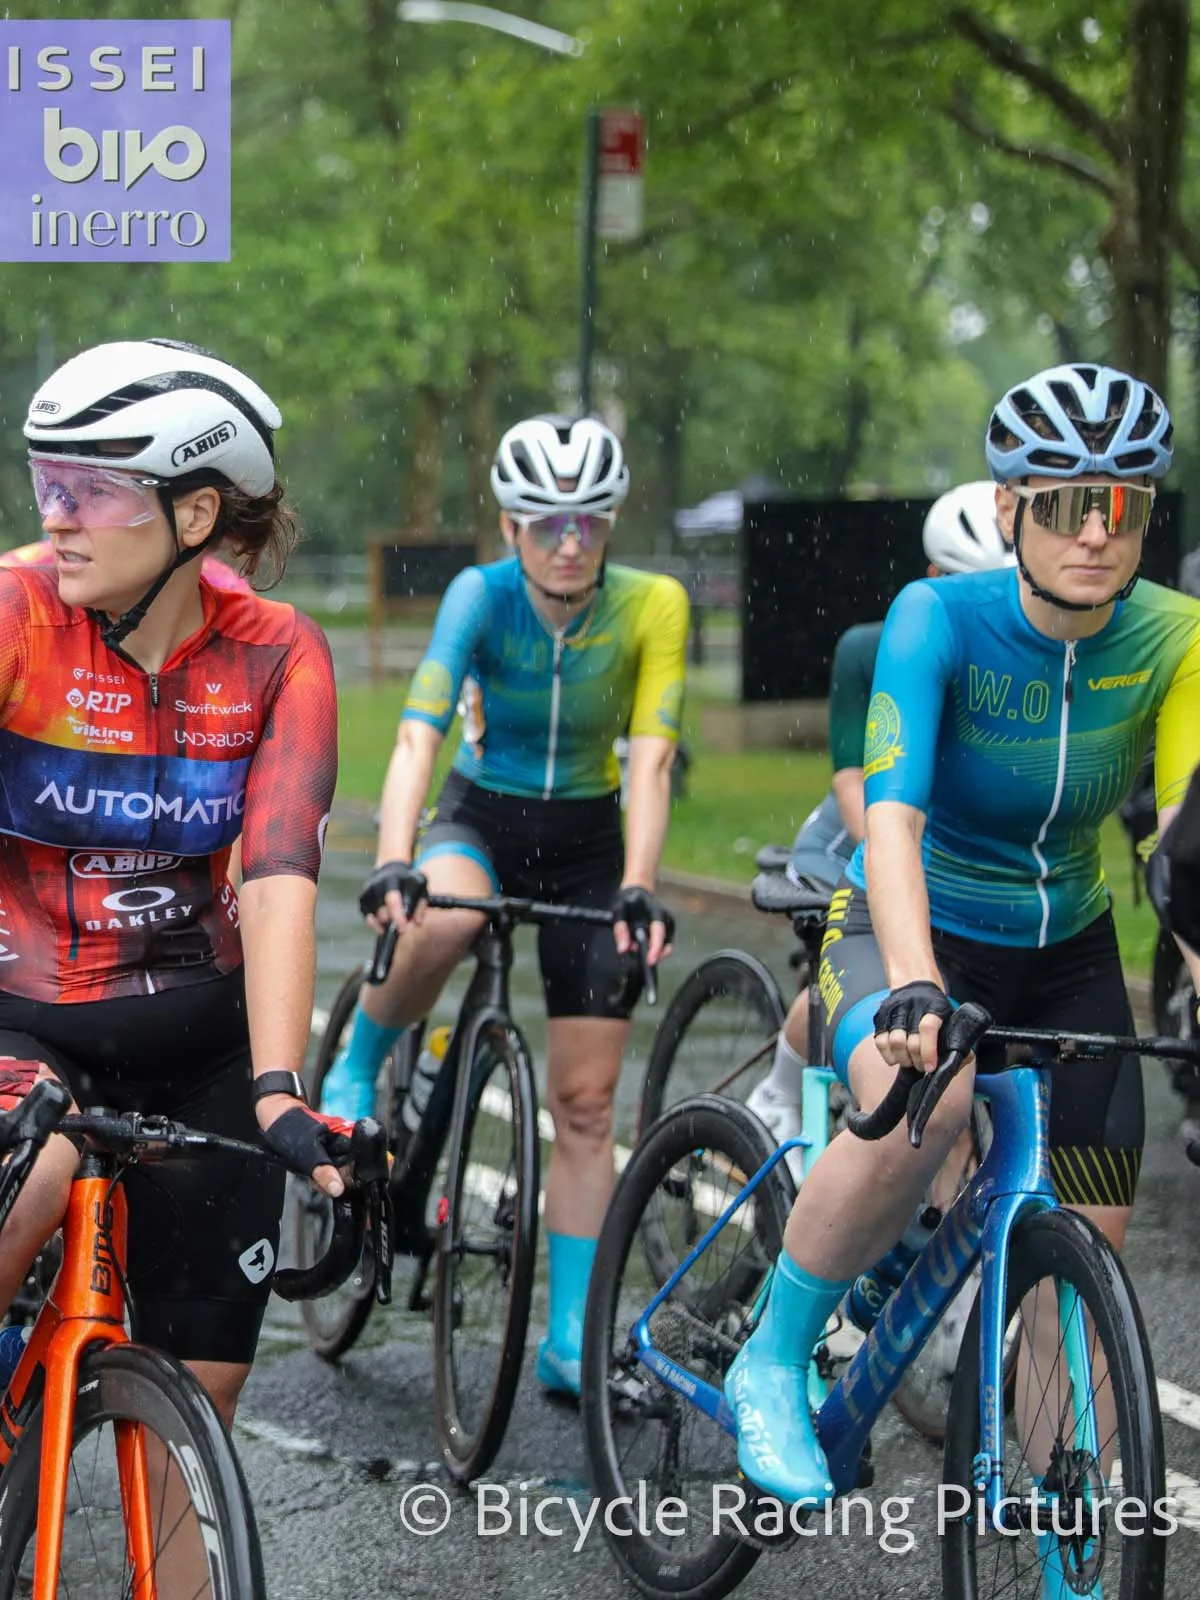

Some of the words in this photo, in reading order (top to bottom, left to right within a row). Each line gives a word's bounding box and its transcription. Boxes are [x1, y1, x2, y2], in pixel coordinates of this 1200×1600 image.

[182, 427, 231, 463] ABUS
[86, 672, 126, 685] PISSEI
[1087, 668, 1153, 692] VERGE
[84, 690, 132, 714] RIP
[175, 700, 252, 716] Swiftwick
[71, 723, 134, 743] viking
[34, 779, 245, 825] AUTOMATIC
[85, 904, 193, 932] OAKLEY
